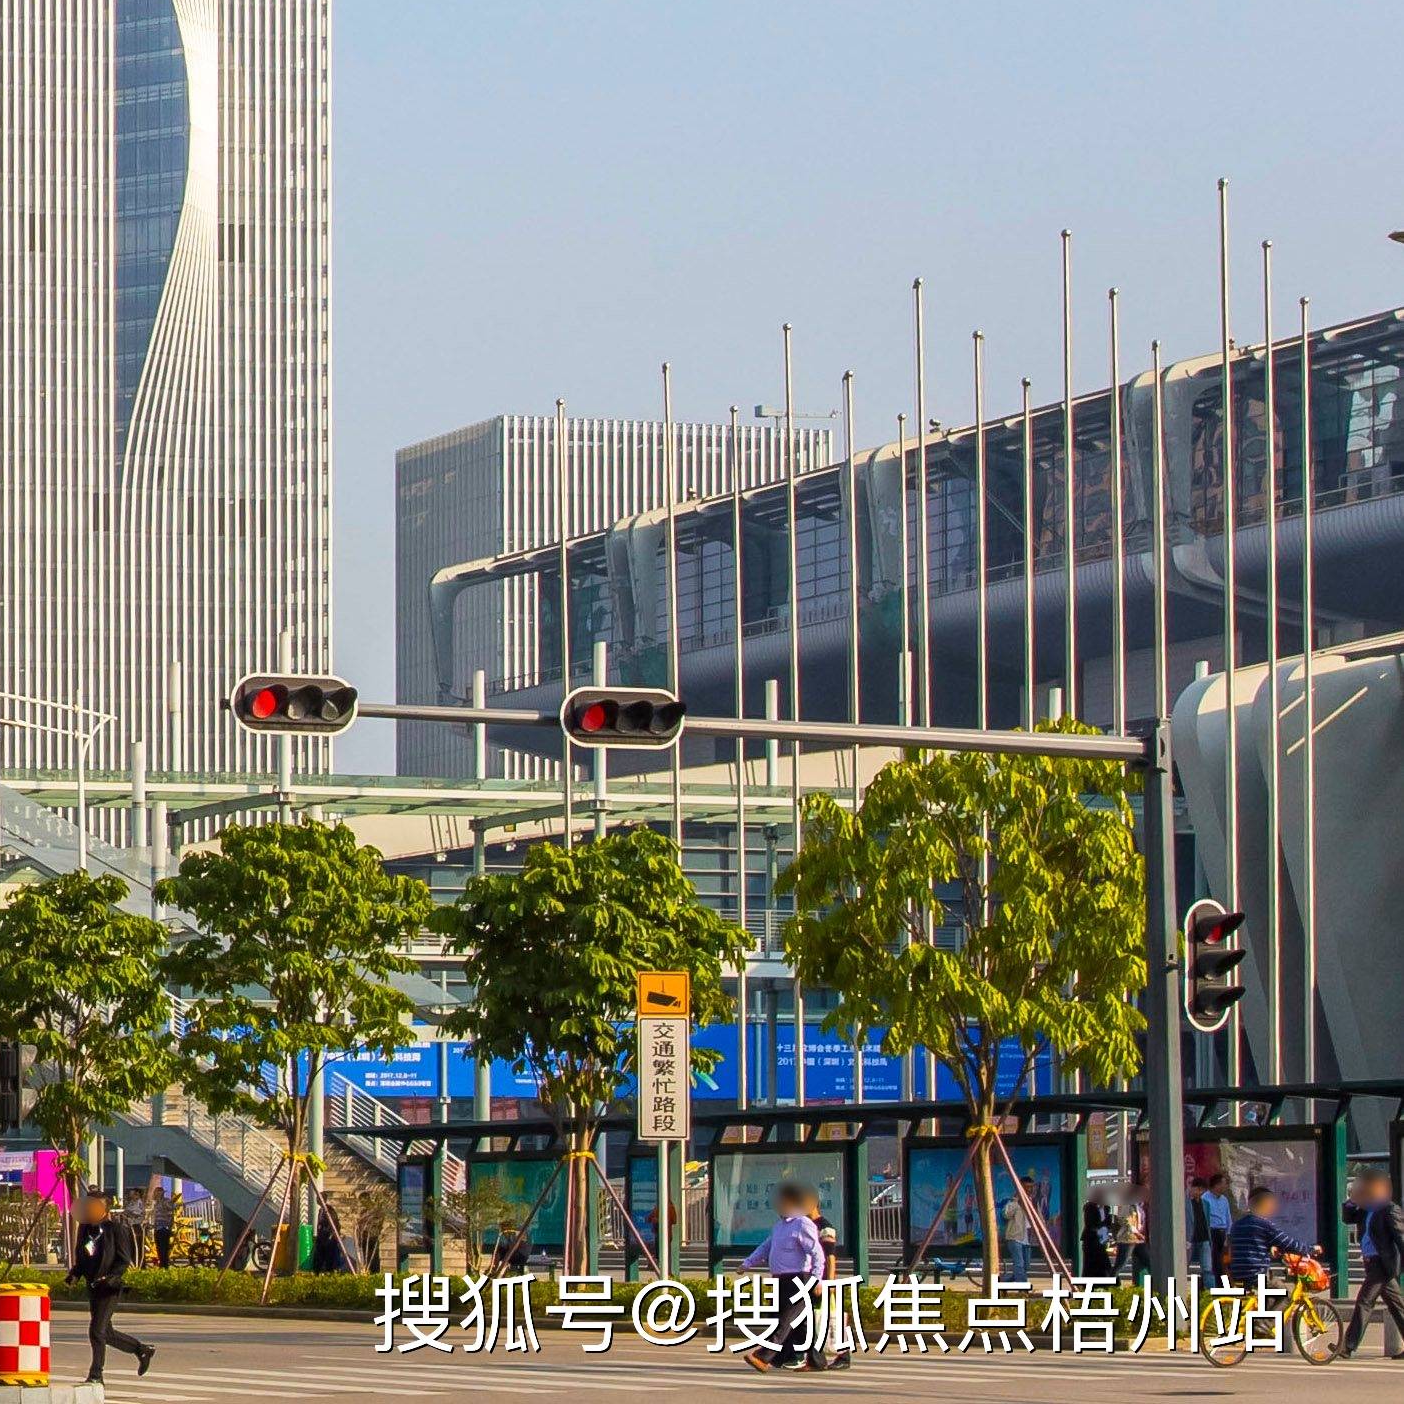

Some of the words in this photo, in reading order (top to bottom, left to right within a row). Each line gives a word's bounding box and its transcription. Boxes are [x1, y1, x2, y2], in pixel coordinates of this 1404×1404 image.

[652, 1022, 676, 1132] 交通繁忙路段
